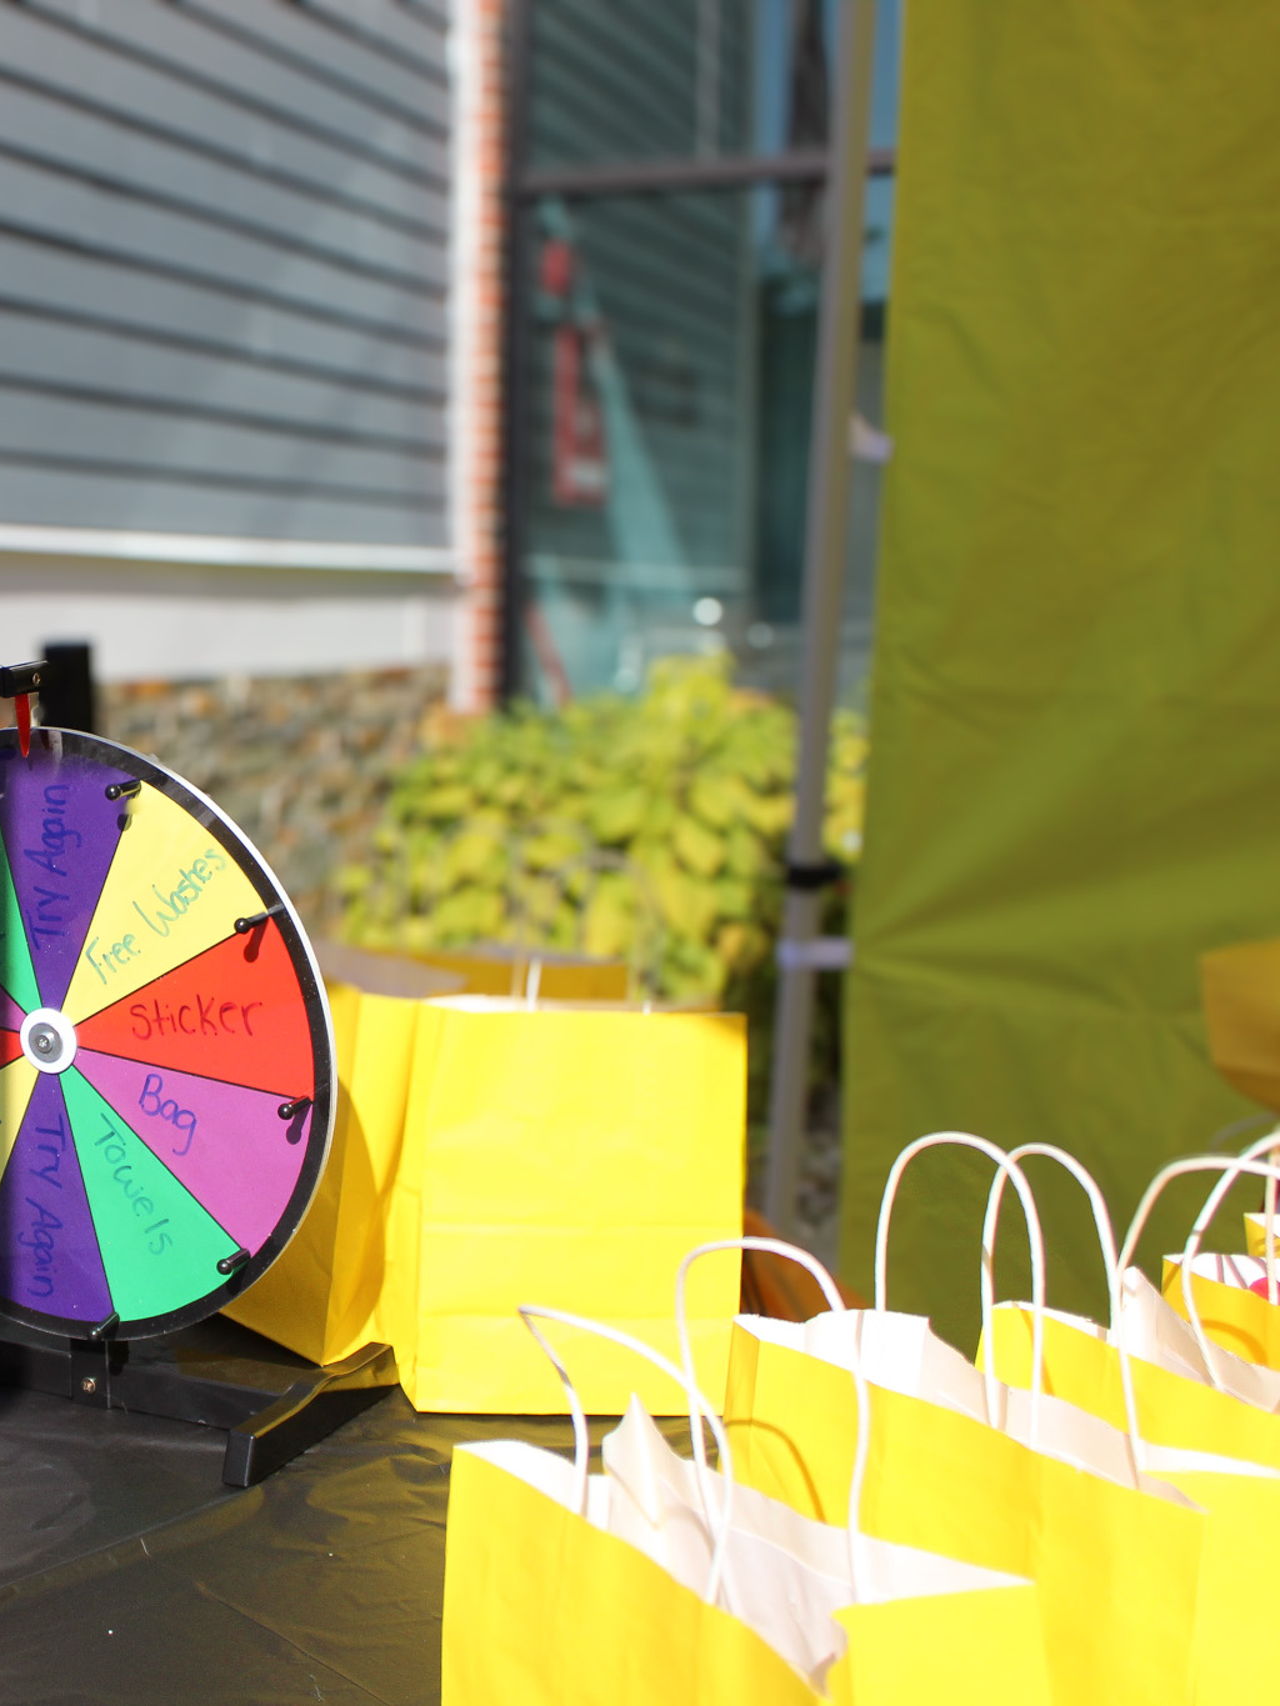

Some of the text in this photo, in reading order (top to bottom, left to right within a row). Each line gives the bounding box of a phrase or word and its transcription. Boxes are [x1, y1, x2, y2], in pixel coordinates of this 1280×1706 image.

[24, 785, 82, 877] Again
[85, 934, 141, 985] Free
[138, 1073, 197, 1156] Bag
[17, 1197, 64, 1297] Again
